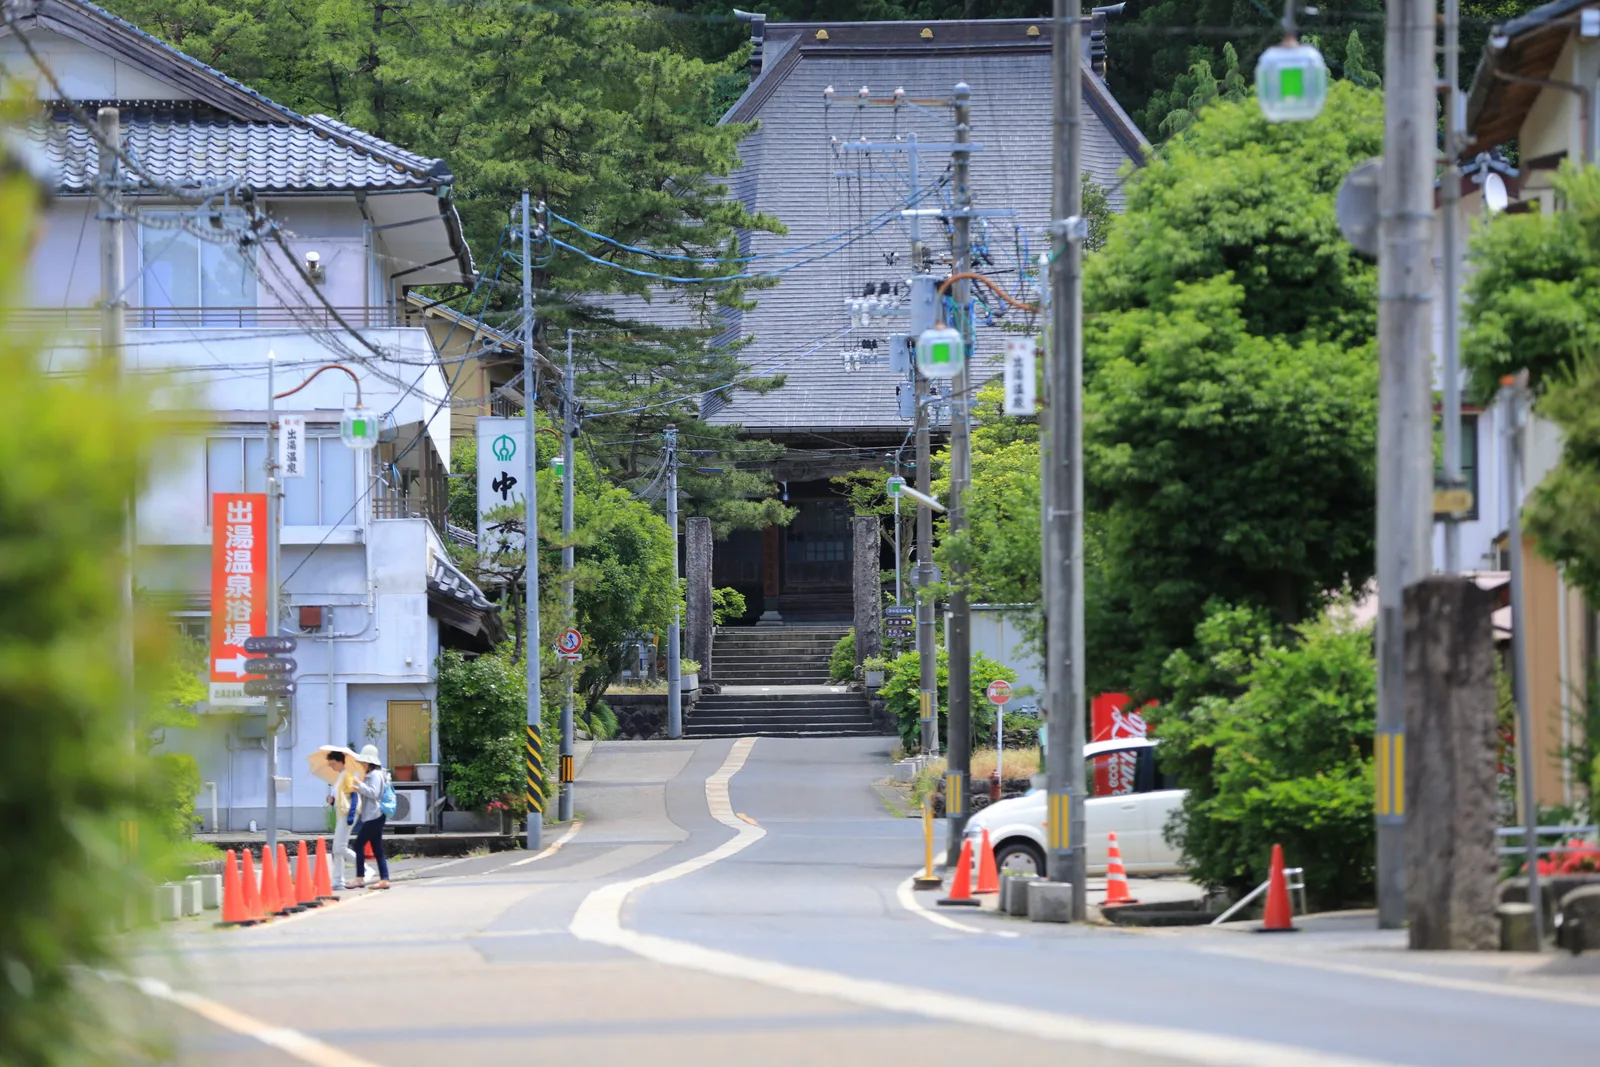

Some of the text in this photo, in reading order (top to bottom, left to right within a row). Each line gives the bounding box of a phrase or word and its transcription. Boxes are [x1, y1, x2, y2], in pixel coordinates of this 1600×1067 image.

[286, 428, 298, 474] 出湯温泉
[224, 500, 254, 648] 出湯温泉浴場
